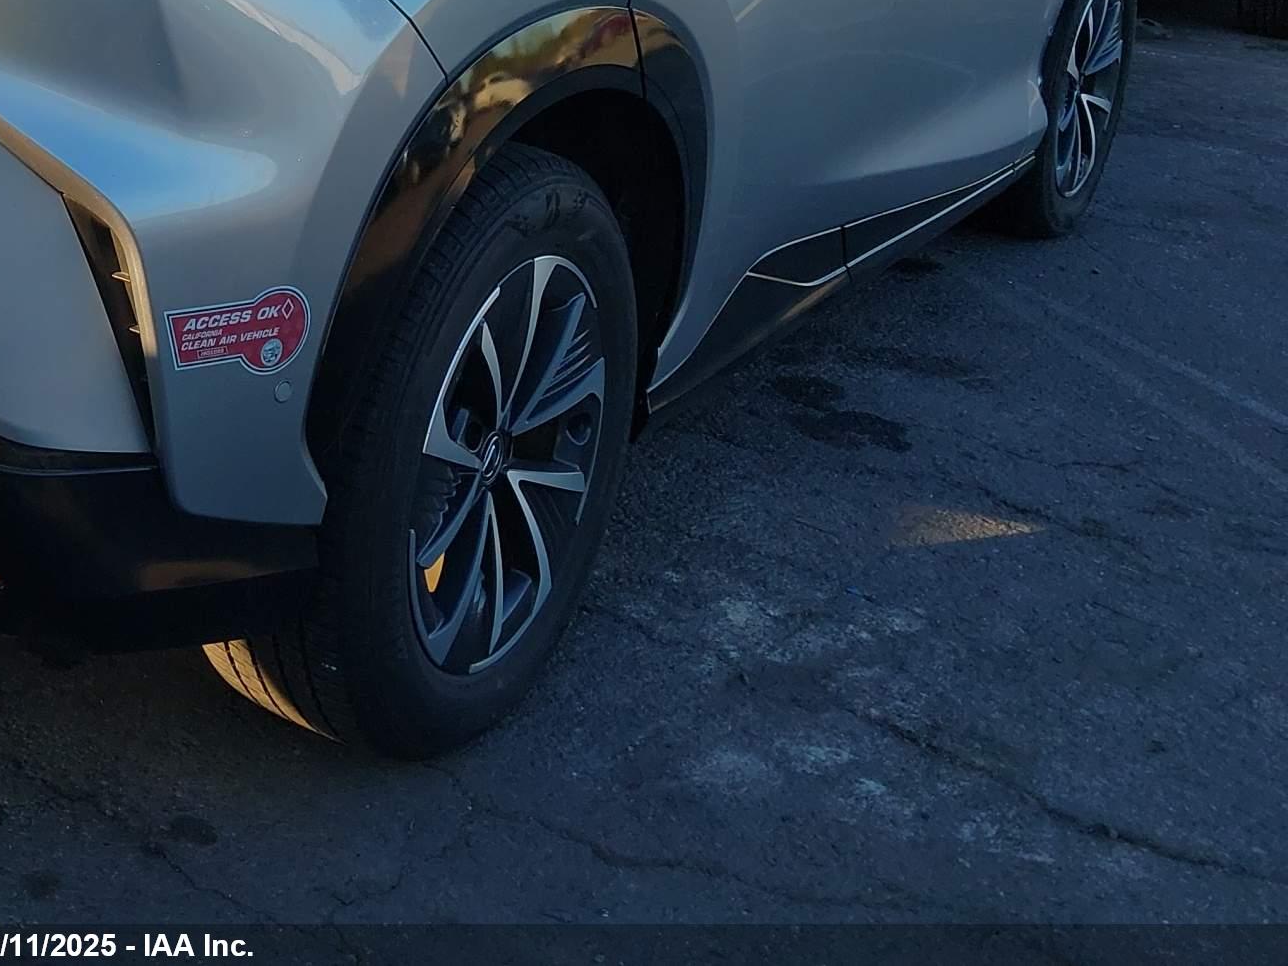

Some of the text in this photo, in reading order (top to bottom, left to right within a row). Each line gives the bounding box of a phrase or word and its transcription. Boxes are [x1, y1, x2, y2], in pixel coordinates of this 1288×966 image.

[183, 304, 282, 331] ACCESS OK
[181, 328, 223, 342] CALIFORNIA
[181, 327, 280, 351] CLEAN AIR VEHICLE
